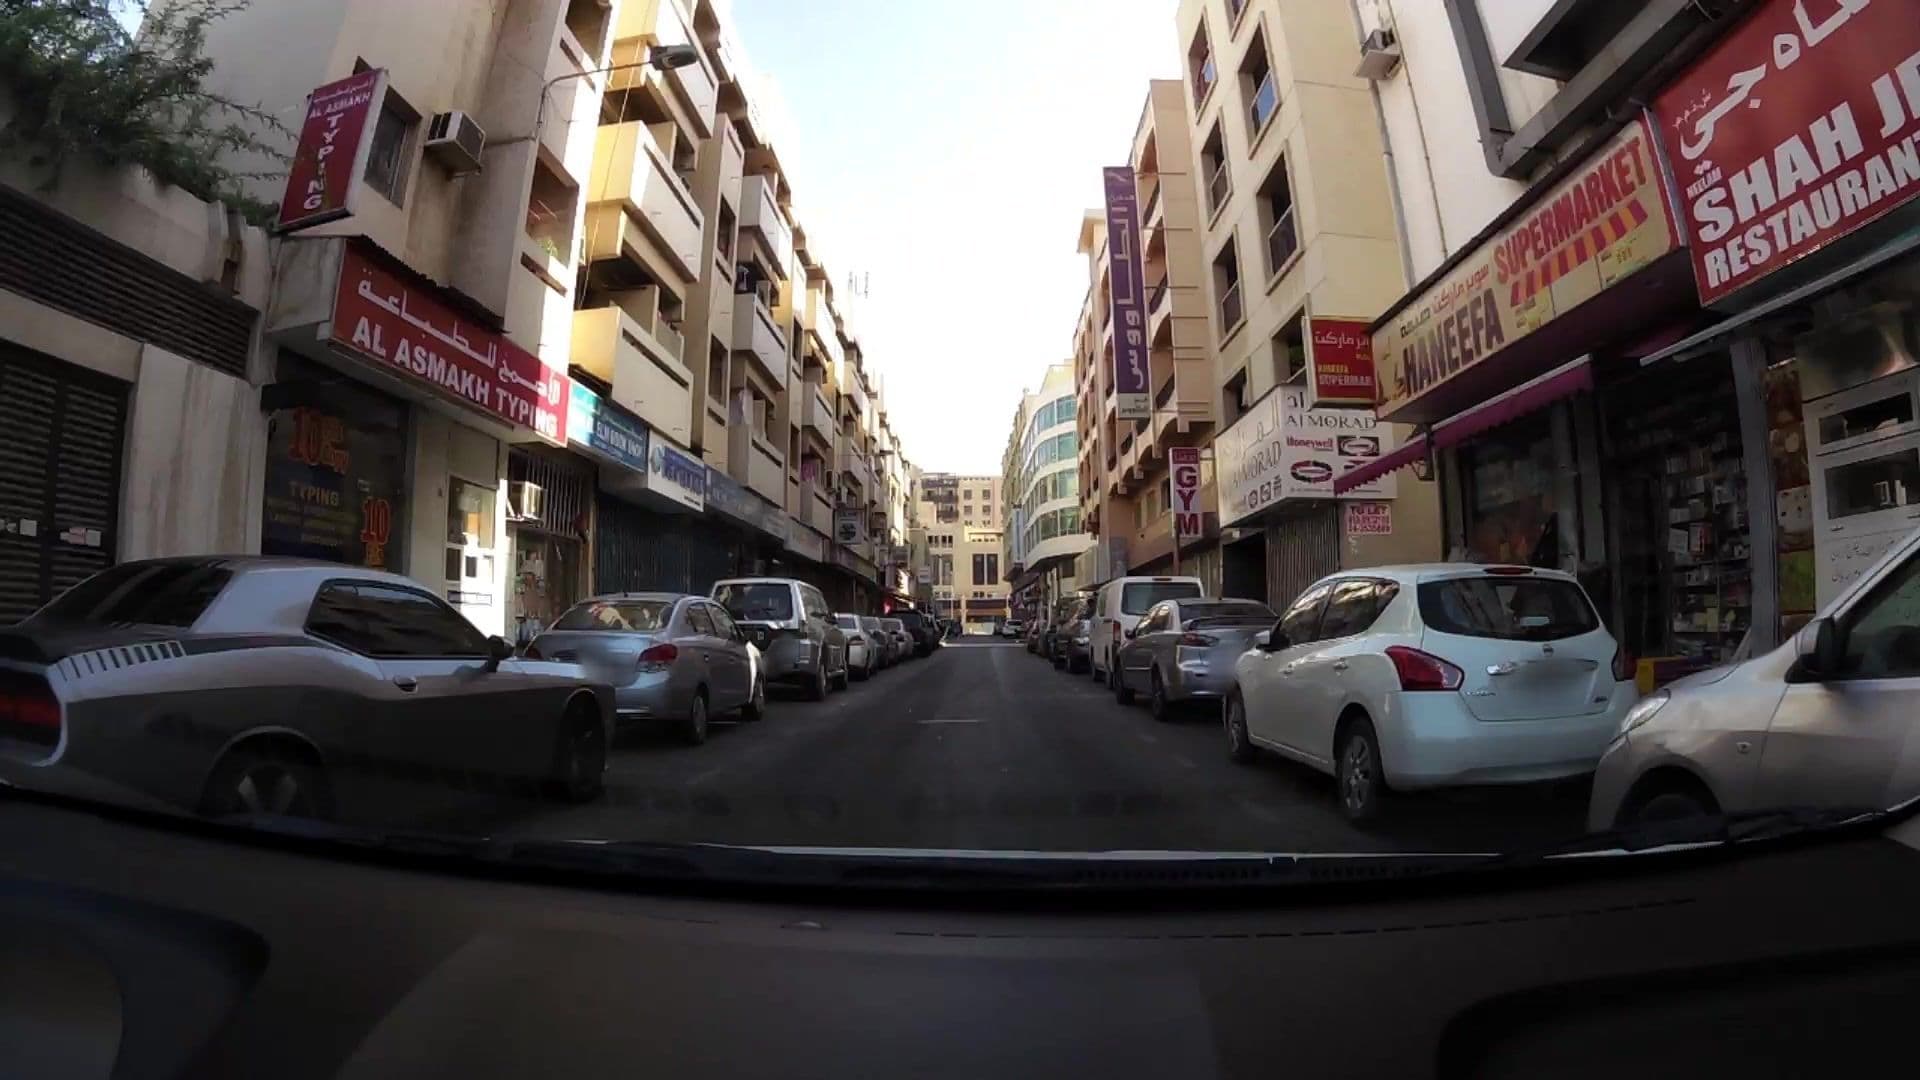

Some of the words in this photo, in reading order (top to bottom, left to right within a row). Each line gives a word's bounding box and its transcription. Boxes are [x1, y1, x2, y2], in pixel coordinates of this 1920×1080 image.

[304, 113, 344, 210] TYPING
[1493, 135, 1647, 285] SUPERMARKET
[1693, 101, 1864, 242] SHAH
[1703, 130, 1920, 289] RESTAURAN
[358, 267, 497, 369] للطباعة
[1402, 287, 1505, 399] HANEEFA
[352, 316, 387, 358] AL
[394, 337, 490, 405] ASMAKH
[495, 387, 559, 438] TYPING
[1286, 435, 1333, 449] Honeywell
[1176, 466, 1199, 535] GYM
